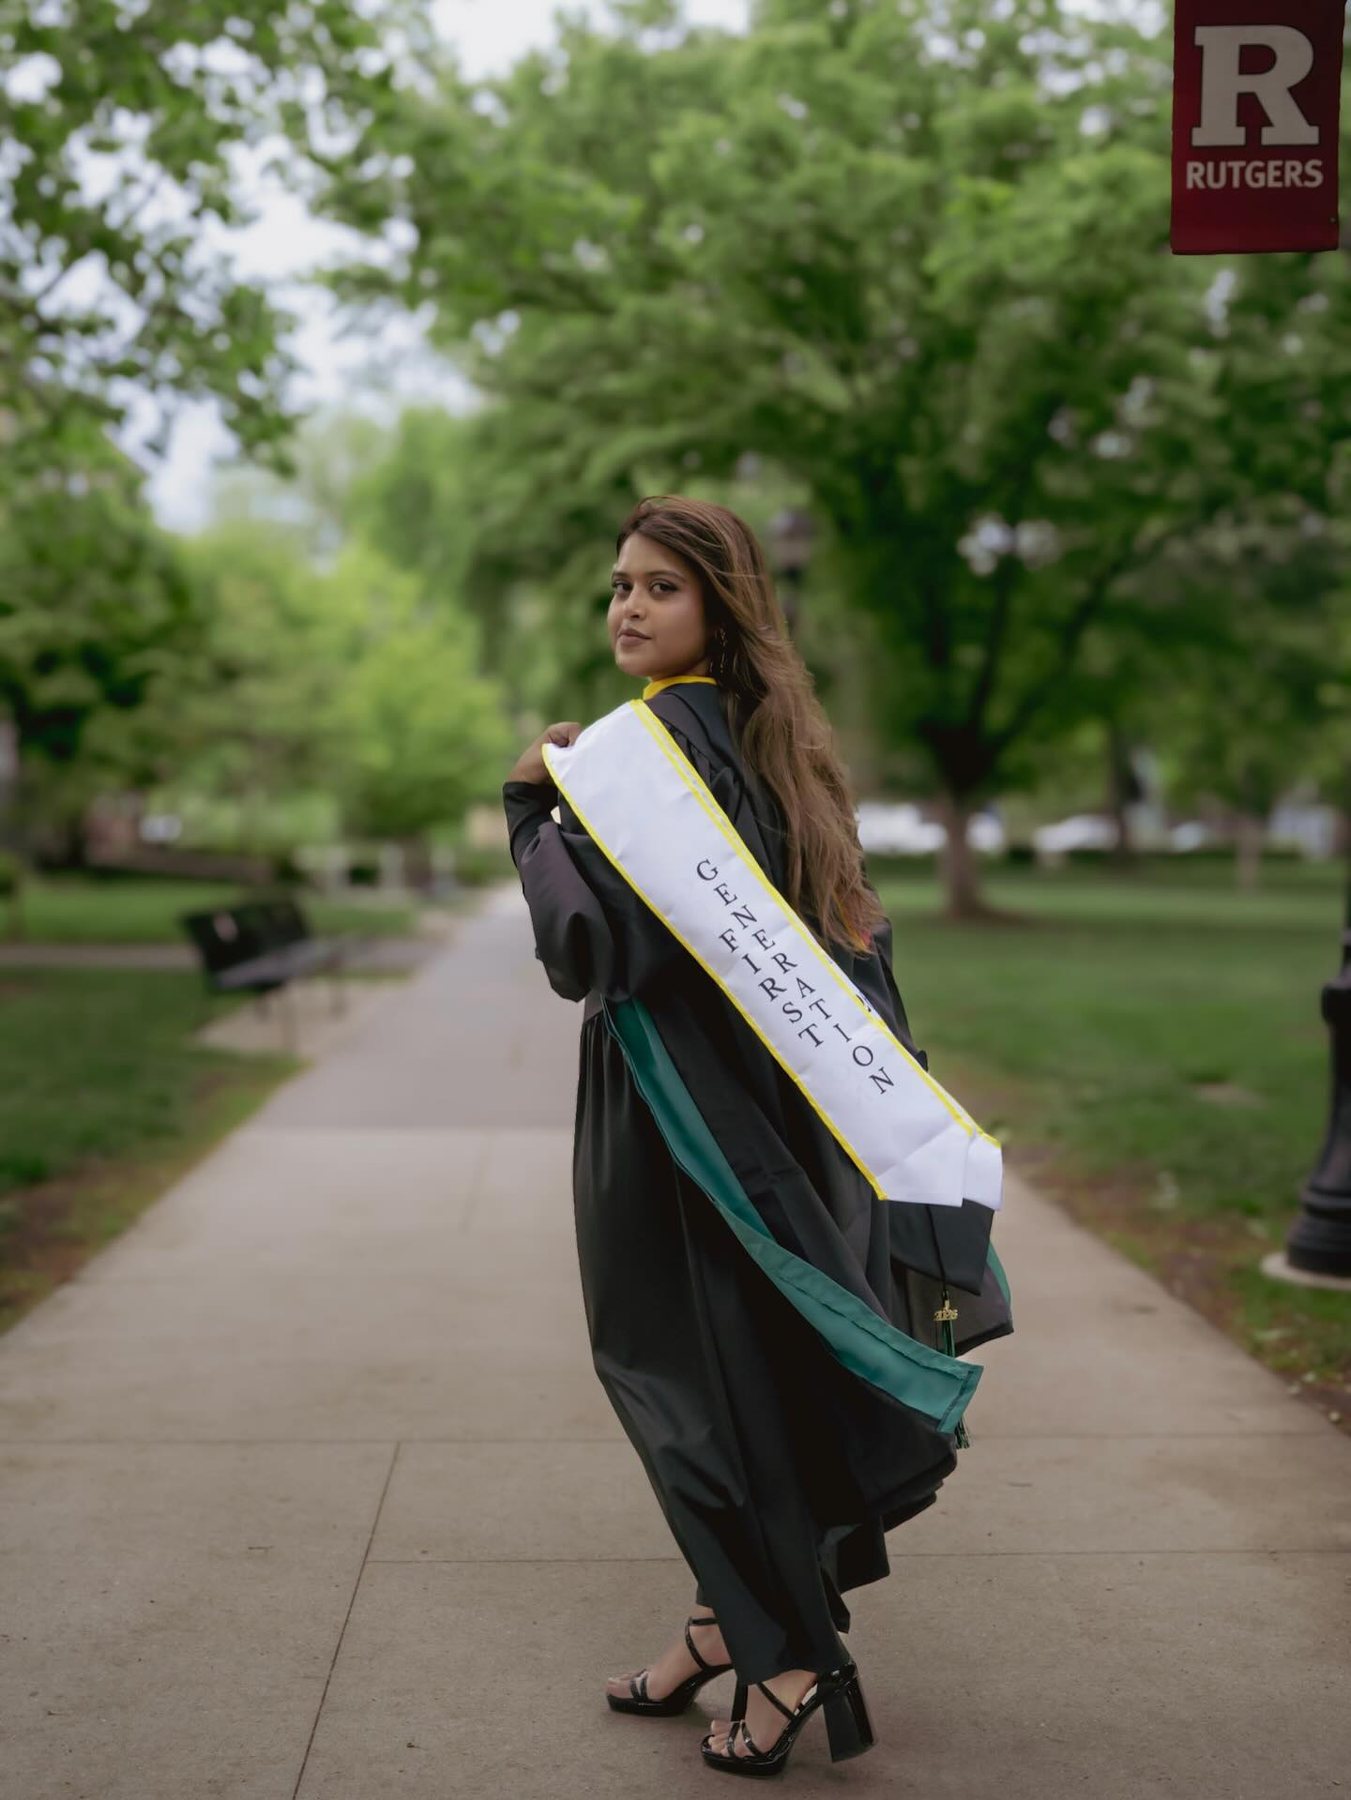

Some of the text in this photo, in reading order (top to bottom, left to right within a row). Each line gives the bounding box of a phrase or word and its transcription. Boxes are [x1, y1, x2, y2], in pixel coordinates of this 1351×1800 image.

[1191, 24, 1319, 146] R
[1186, 159, 1324, 189] RUTGERS
[696, 859, 894, 1095] GENERATION
[719, 928, 824, 1048] FIRST
